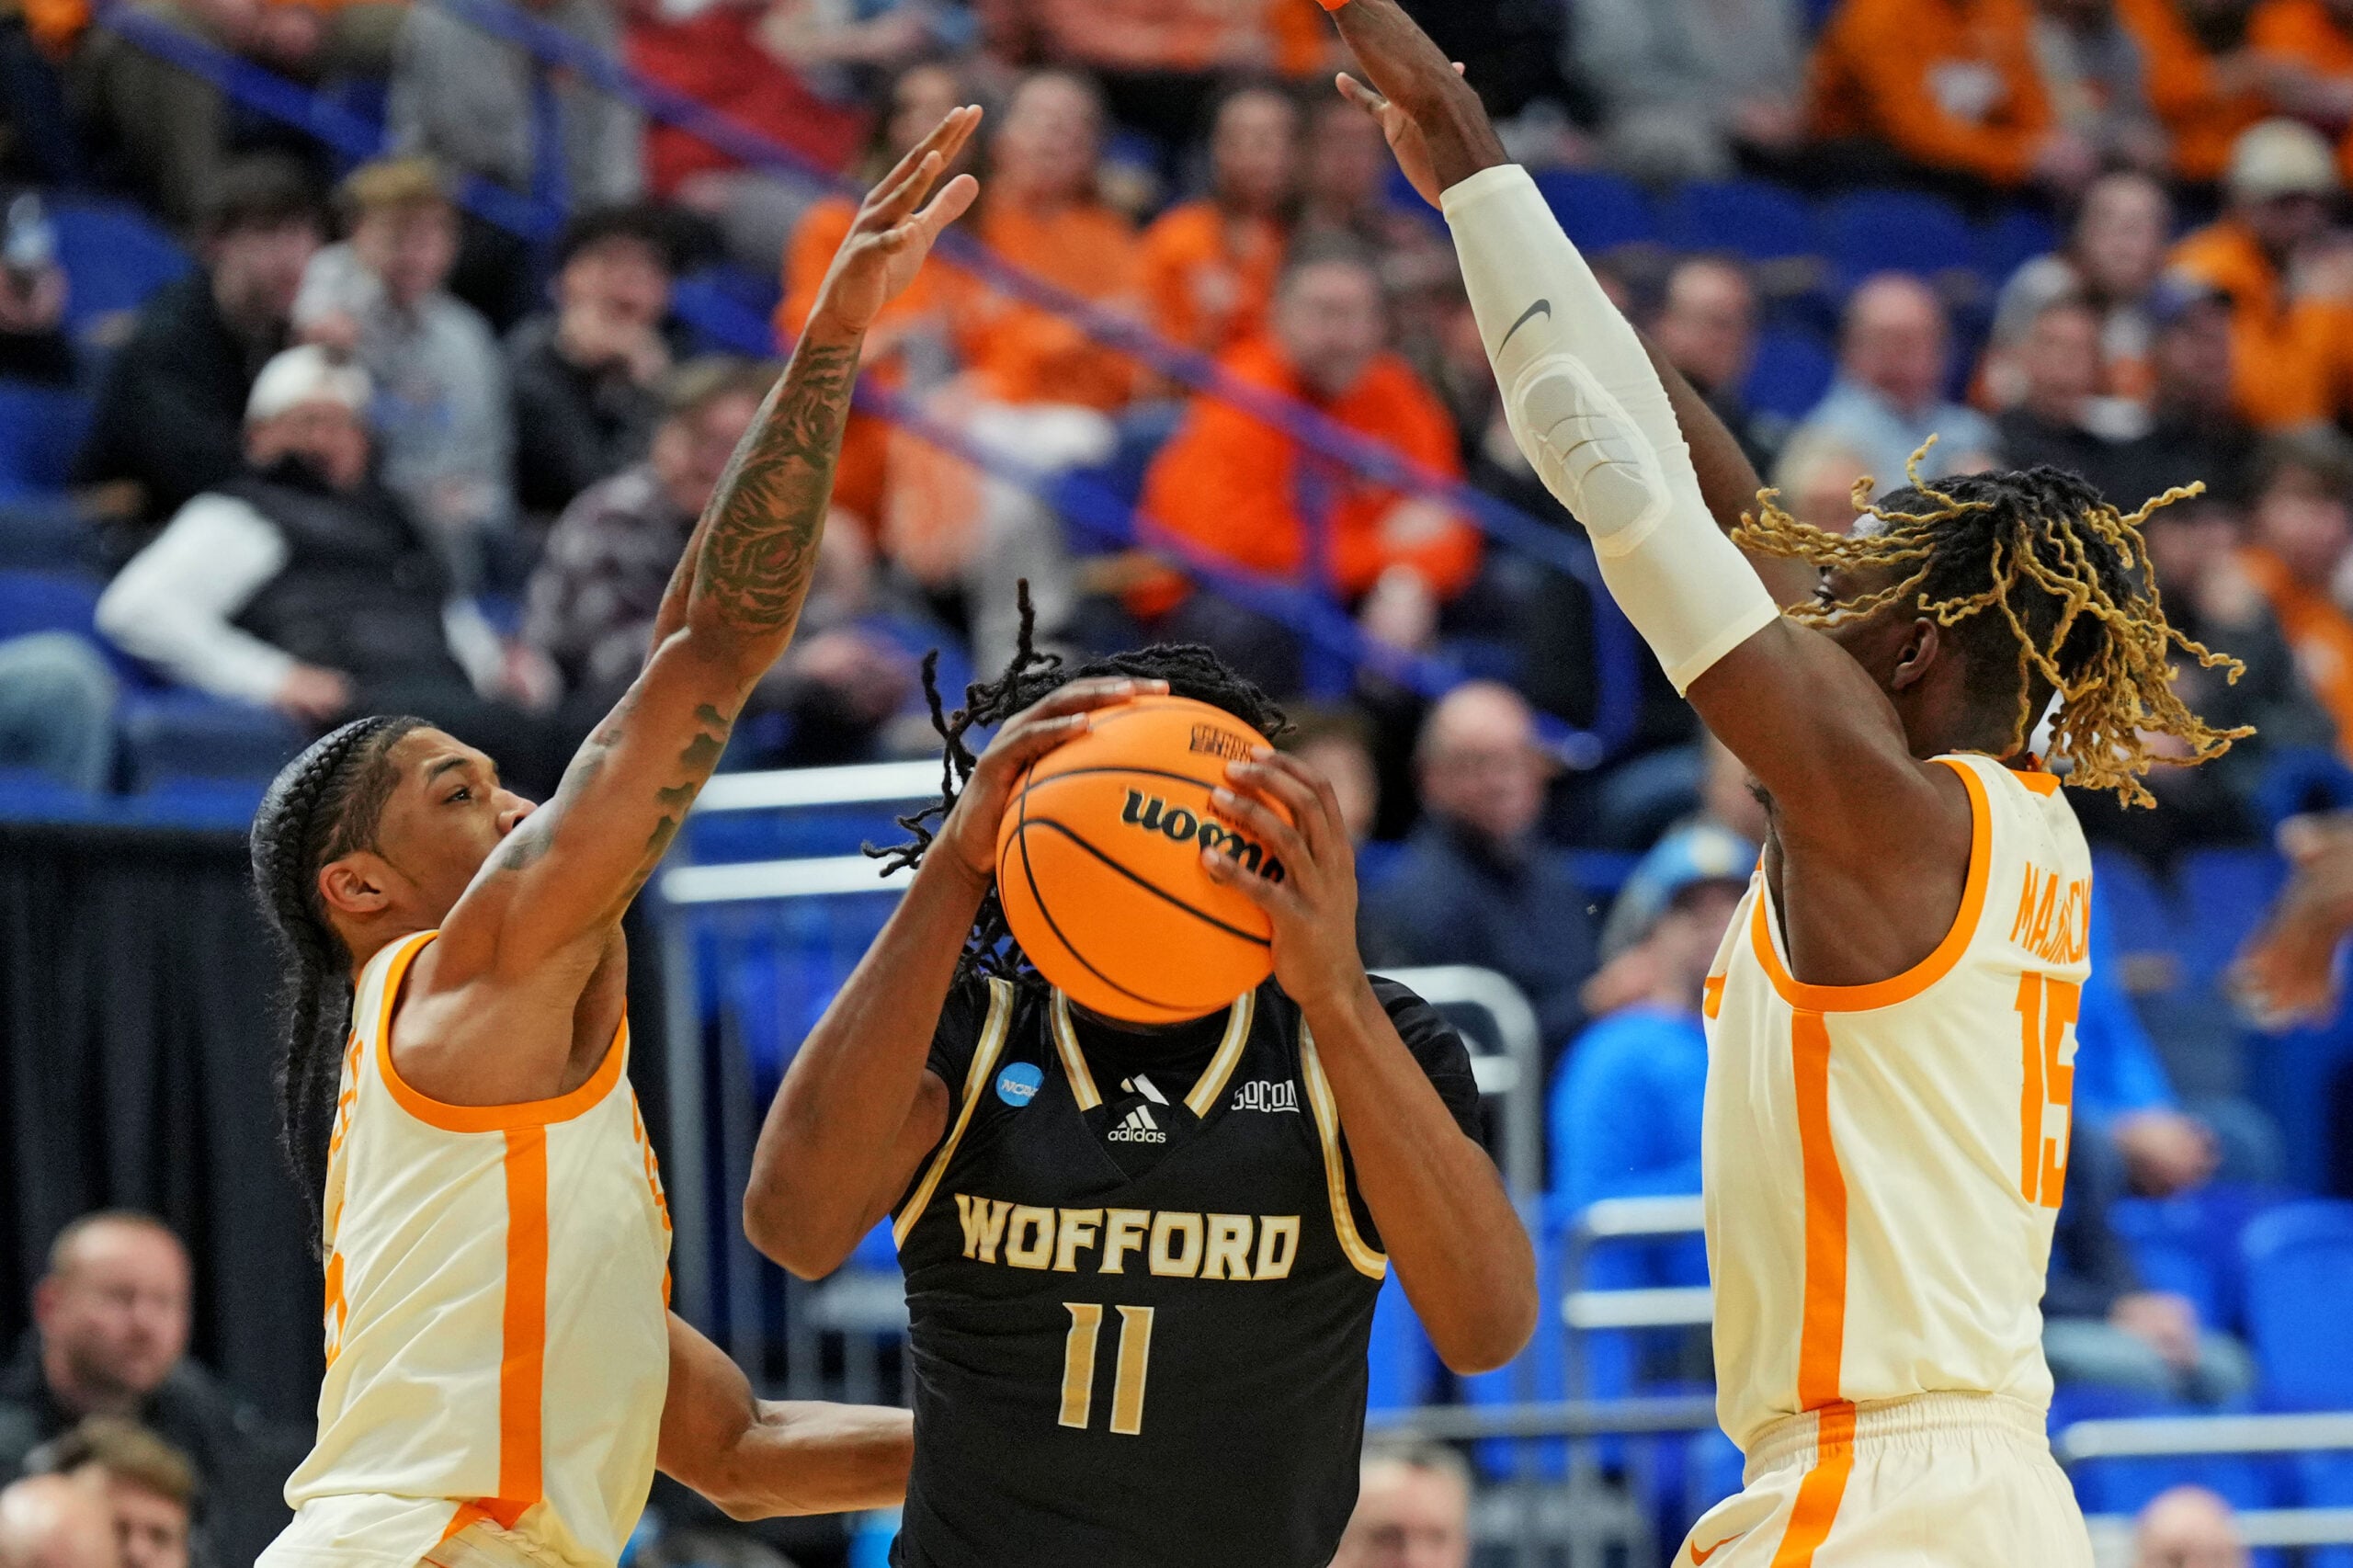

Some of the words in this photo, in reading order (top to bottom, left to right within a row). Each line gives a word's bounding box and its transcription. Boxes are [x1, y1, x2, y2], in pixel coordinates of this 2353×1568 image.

[1108, 1127, 1166, 1143] adidas
[2014, 970, 2081, 1210] 15
[954, 1193, 1301, 1281] WOFFORD
[1058, 1301, 1154, 1436] 11
